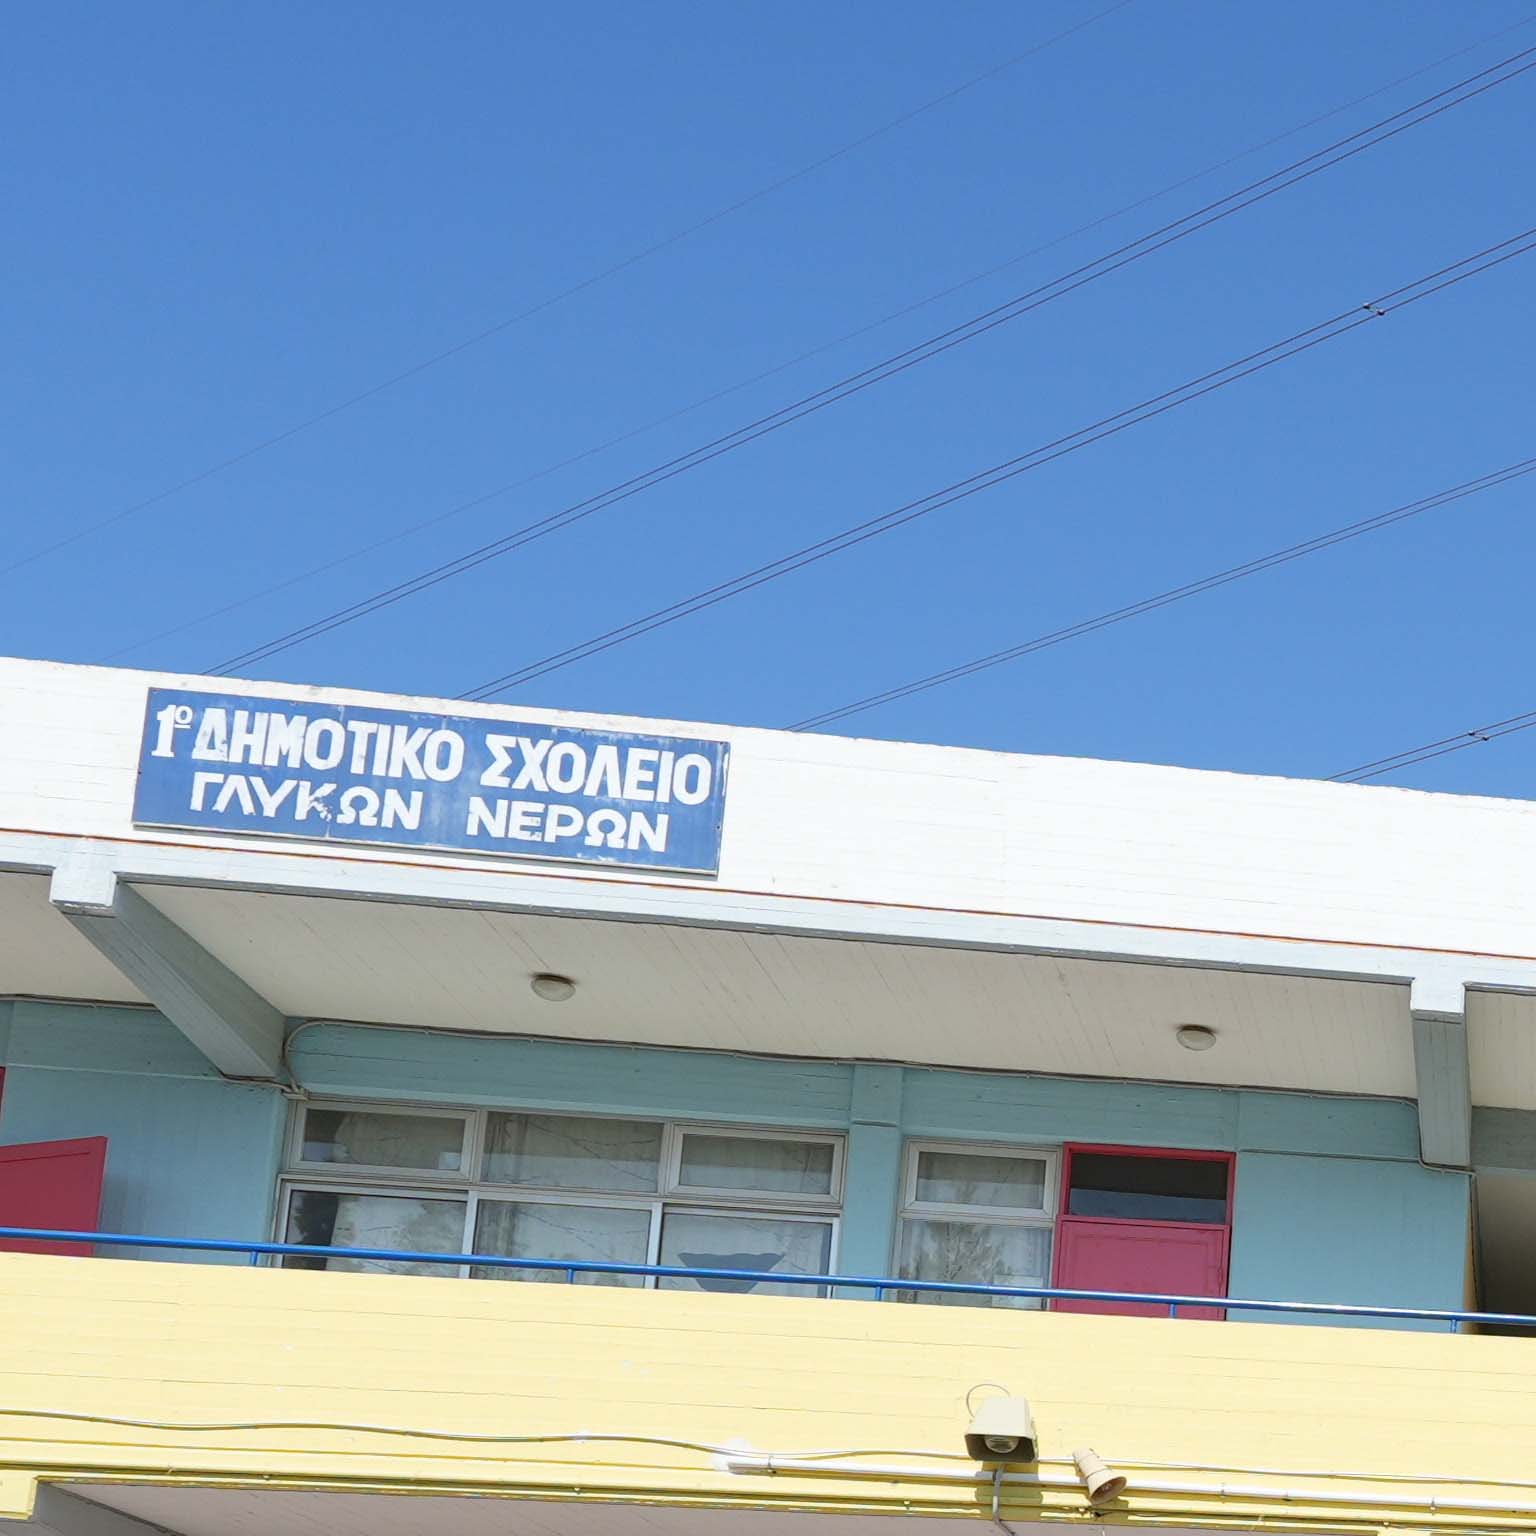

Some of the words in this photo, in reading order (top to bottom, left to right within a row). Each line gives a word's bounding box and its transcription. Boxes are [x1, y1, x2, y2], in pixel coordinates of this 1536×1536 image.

[191, 707, 465, 782] ΔΗΜΟΤΙΚΟ
[479, 733, 712, 806] ΣΧΟΛΕΙΟ
[189, 771, 424, 830] ΓΛΥΚΩΝ
[465, 796, 669, 853] ΝΕΡΩΝ
